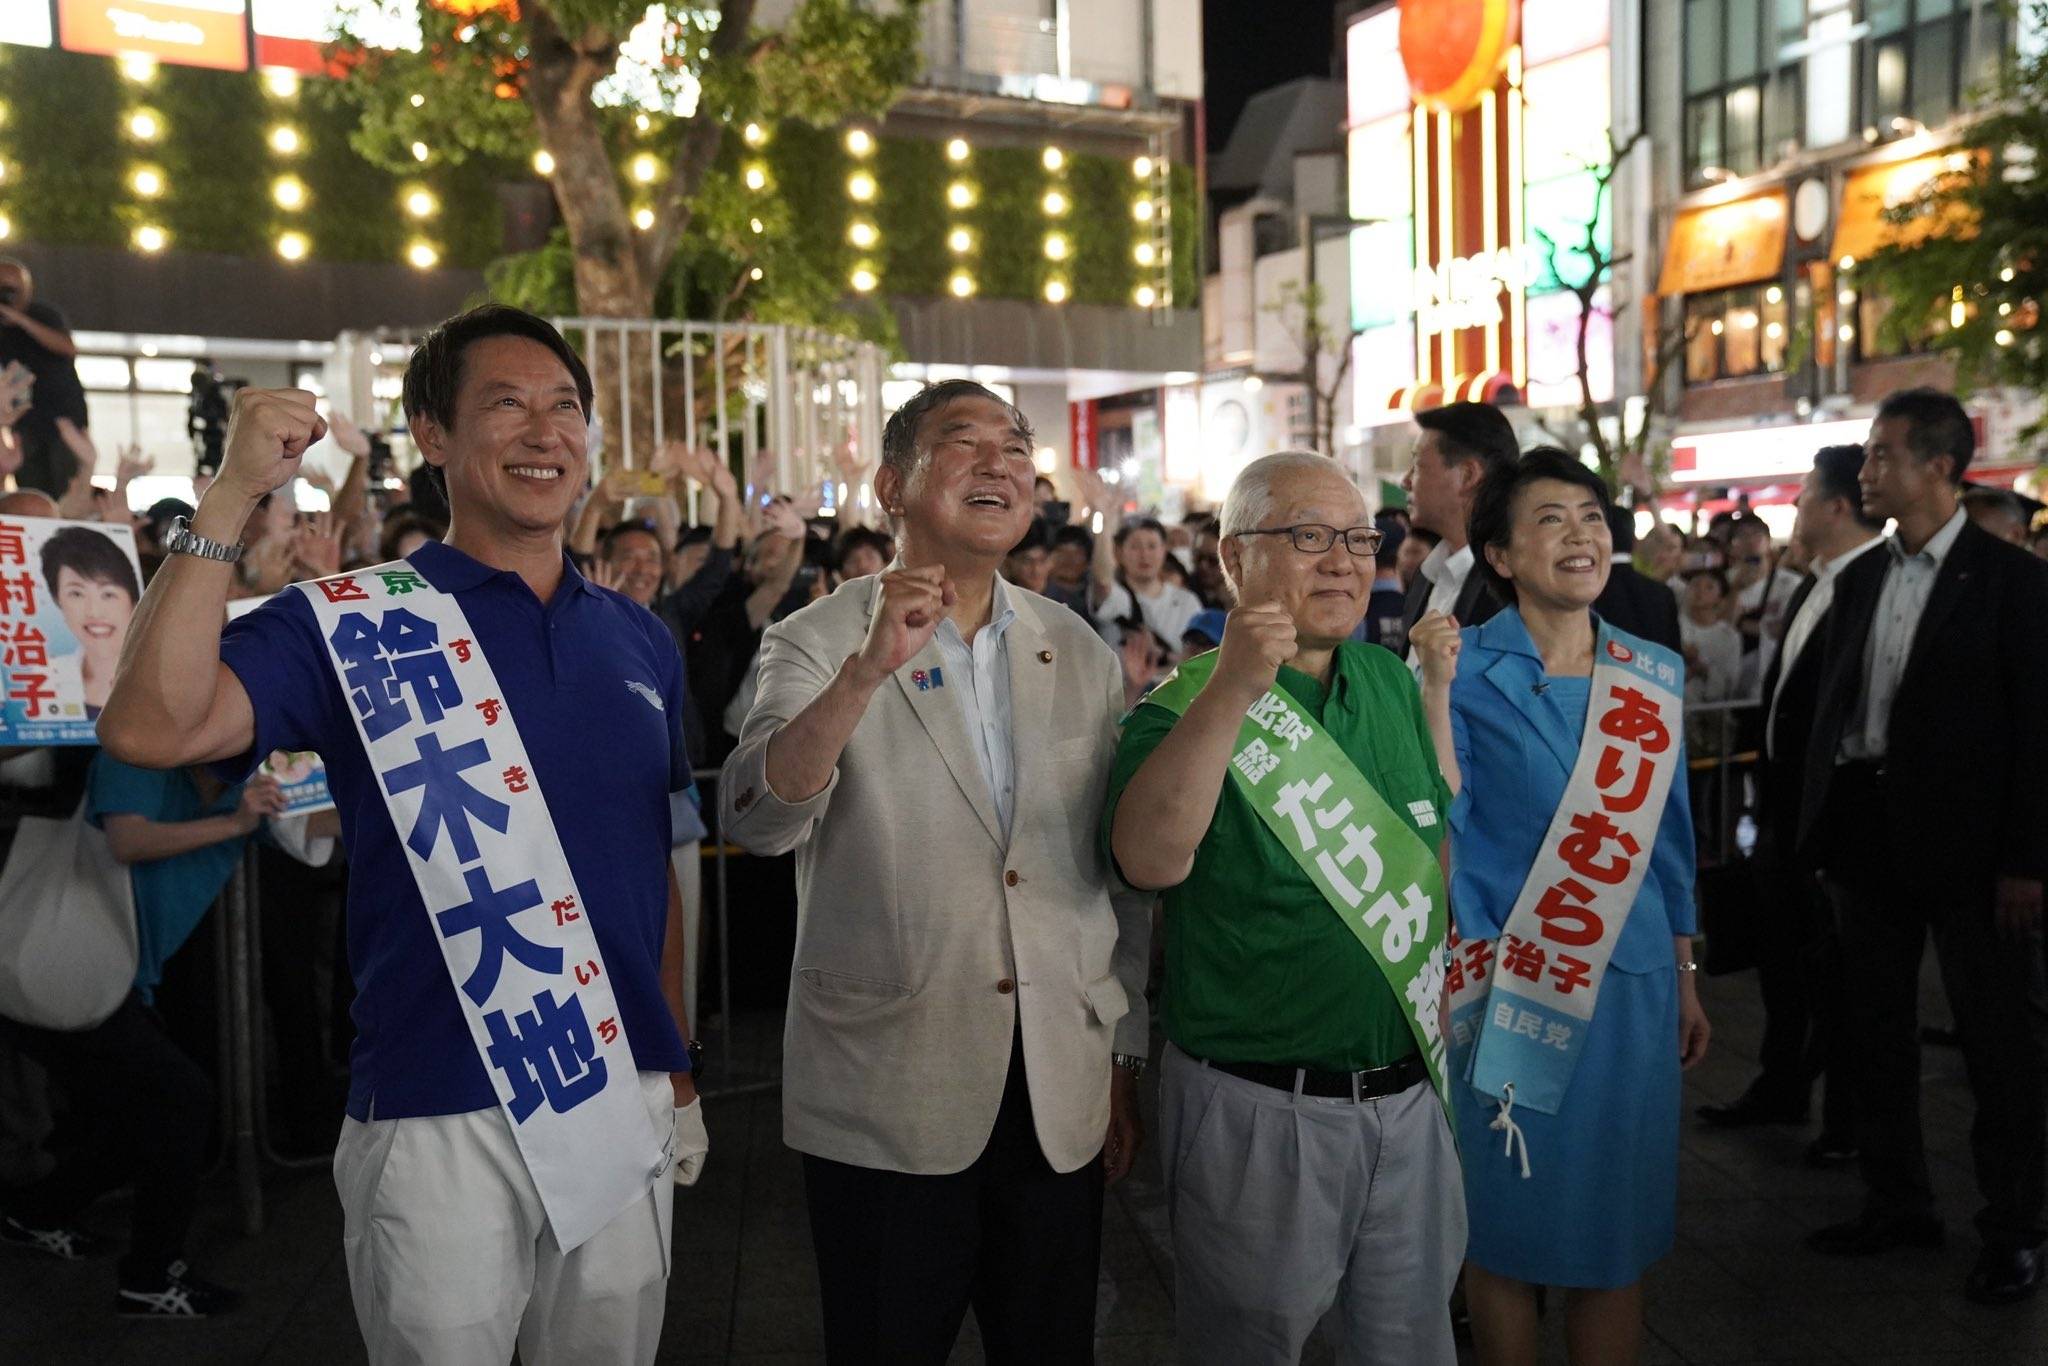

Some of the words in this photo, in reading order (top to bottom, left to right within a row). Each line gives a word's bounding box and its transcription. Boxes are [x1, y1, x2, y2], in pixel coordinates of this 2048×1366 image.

[315, 576, 370, 603] 区
[375, 571, 428, 596] 京
[1634, 650, 1677, 687] 比例
[1232, 737, 1281, 786] 認
[1533, 684, 1670, 947] ありむら
[329, 606, 608, 1126] 鈴木大地
[1502, 935, 1593, 995] 治子
[1493, 1002, 1573, 1051] 自民党
